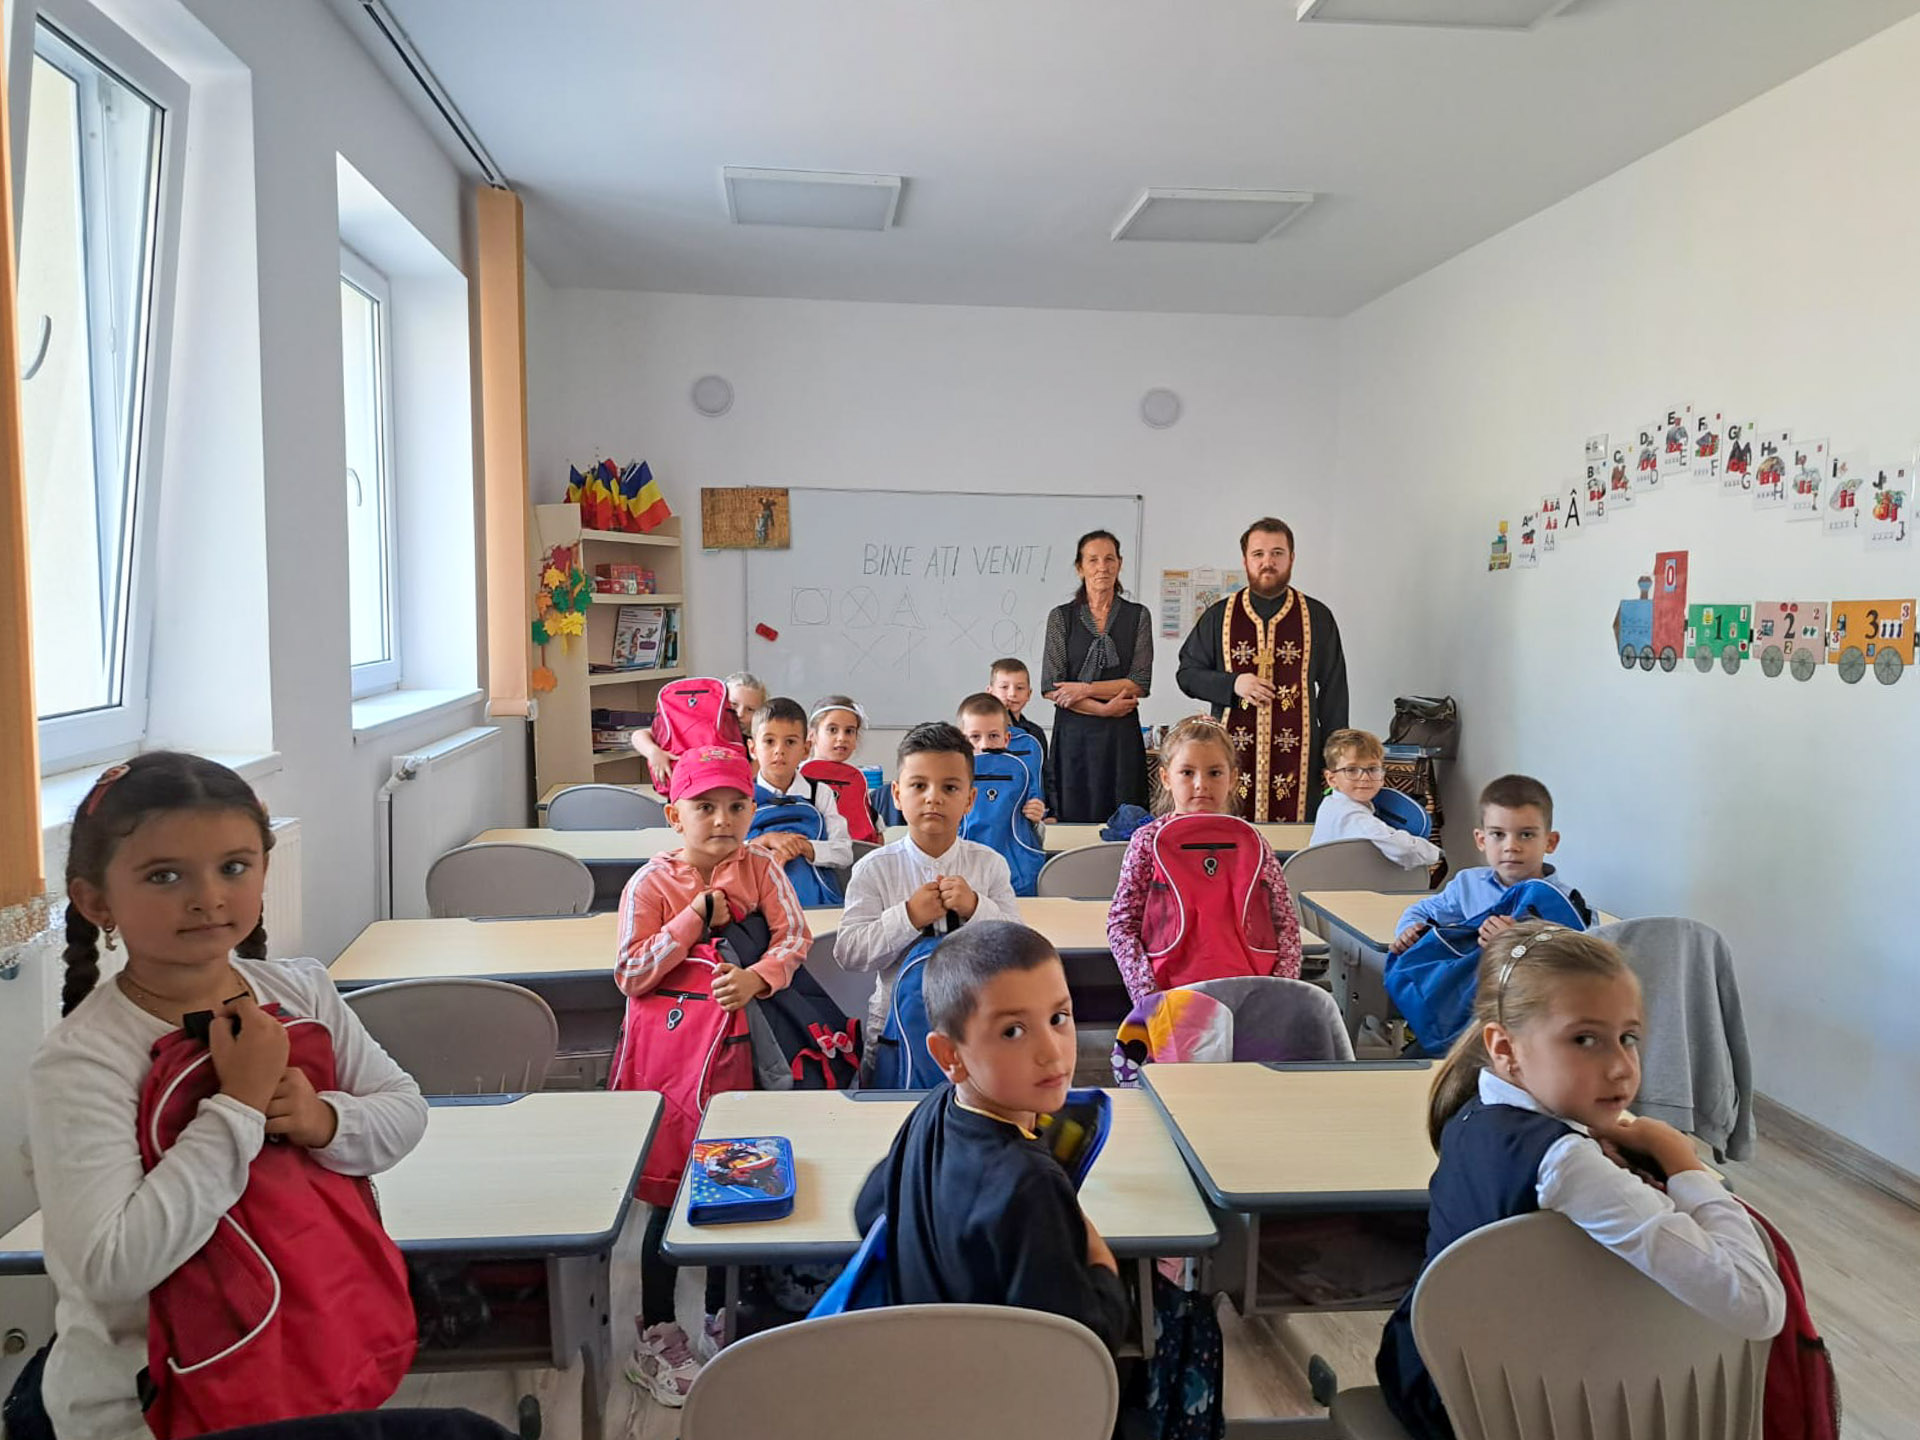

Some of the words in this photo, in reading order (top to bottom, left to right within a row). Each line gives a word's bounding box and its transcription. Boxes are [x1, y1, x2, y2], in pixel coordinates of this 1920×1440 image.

[1667, 411, 1677, 426] E
[1640, 432, 1649, 446] D
[1761, 441, 1772, 457] H
[1587, 466, 1595, 479] B
[1741, 471, 1752, 490] G
[1565, 488, 1580, 528] Â
[863, 543, 916, 577] BINE
[1667, 565, 1675, 586] 0
[1813, 608, 1820, 620] 2
[1901, 605, 1910, 619] 3
[1715, 614, 1723, 641] 1
[1784, 612, 1796, 640] 2
[1865, 609, 1880, 640] 3
[1756, 629, 1764, 641] 2
[1832, 630, 1840, 644] 3
